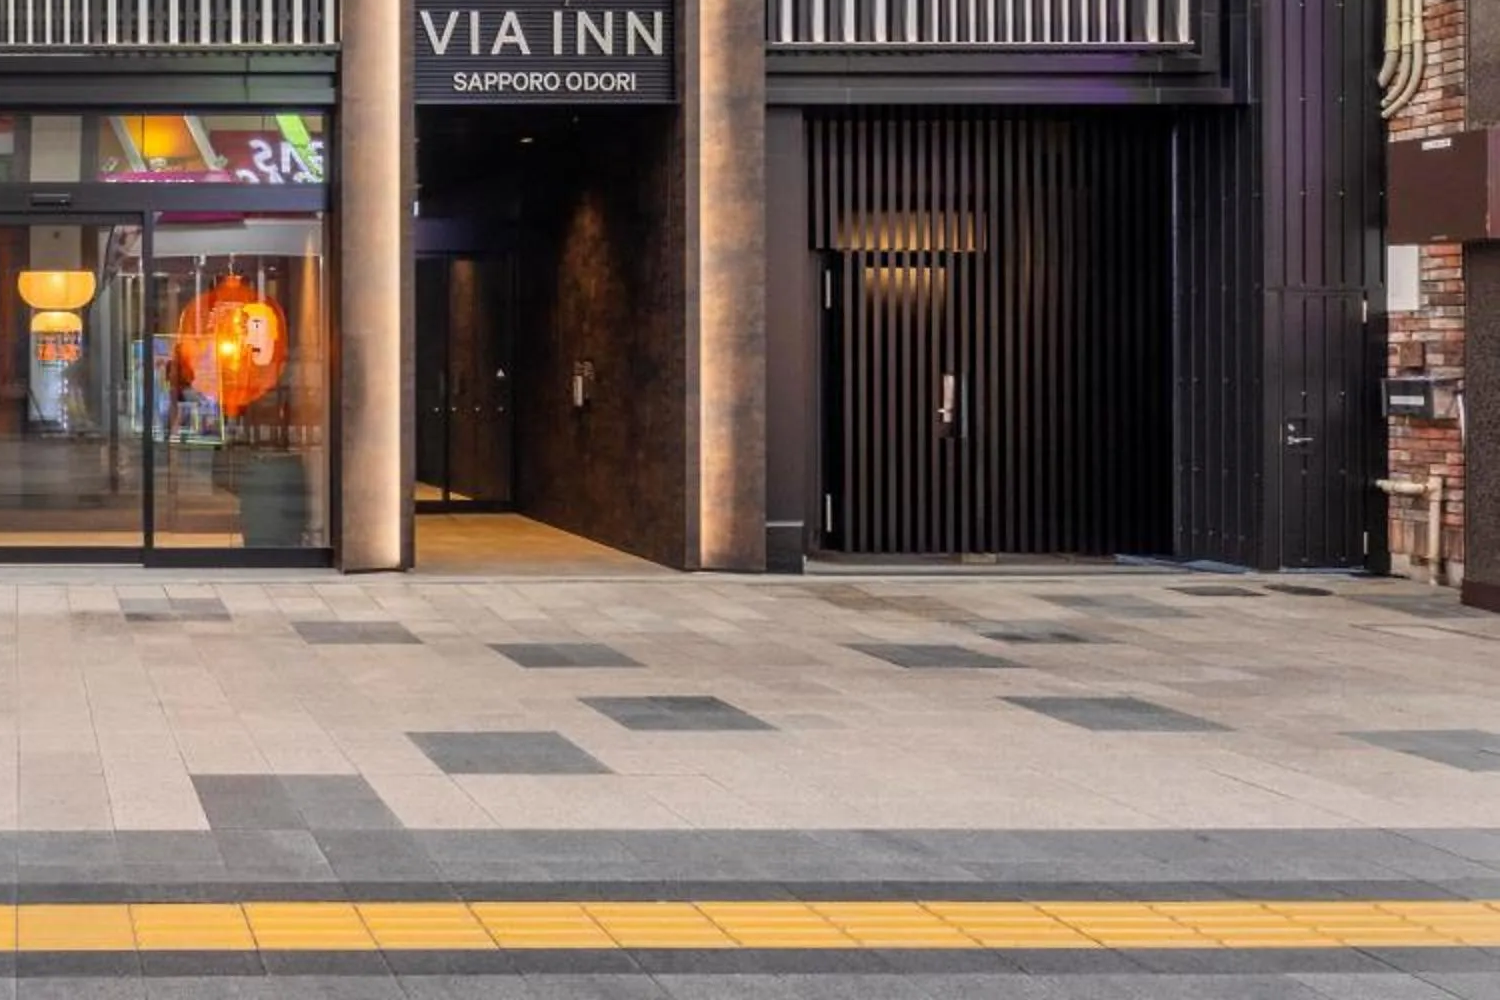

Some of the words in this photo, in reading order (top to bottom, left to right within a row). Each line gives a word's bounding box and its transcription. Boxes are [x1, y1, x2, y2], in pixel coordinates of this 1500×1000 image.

[420, 10, 531, 55] VIA
[553, 10, 663, 55] INN
[453, 72, 560, 92] SAPPORO
[566, 72, 636, 92] ODORI
